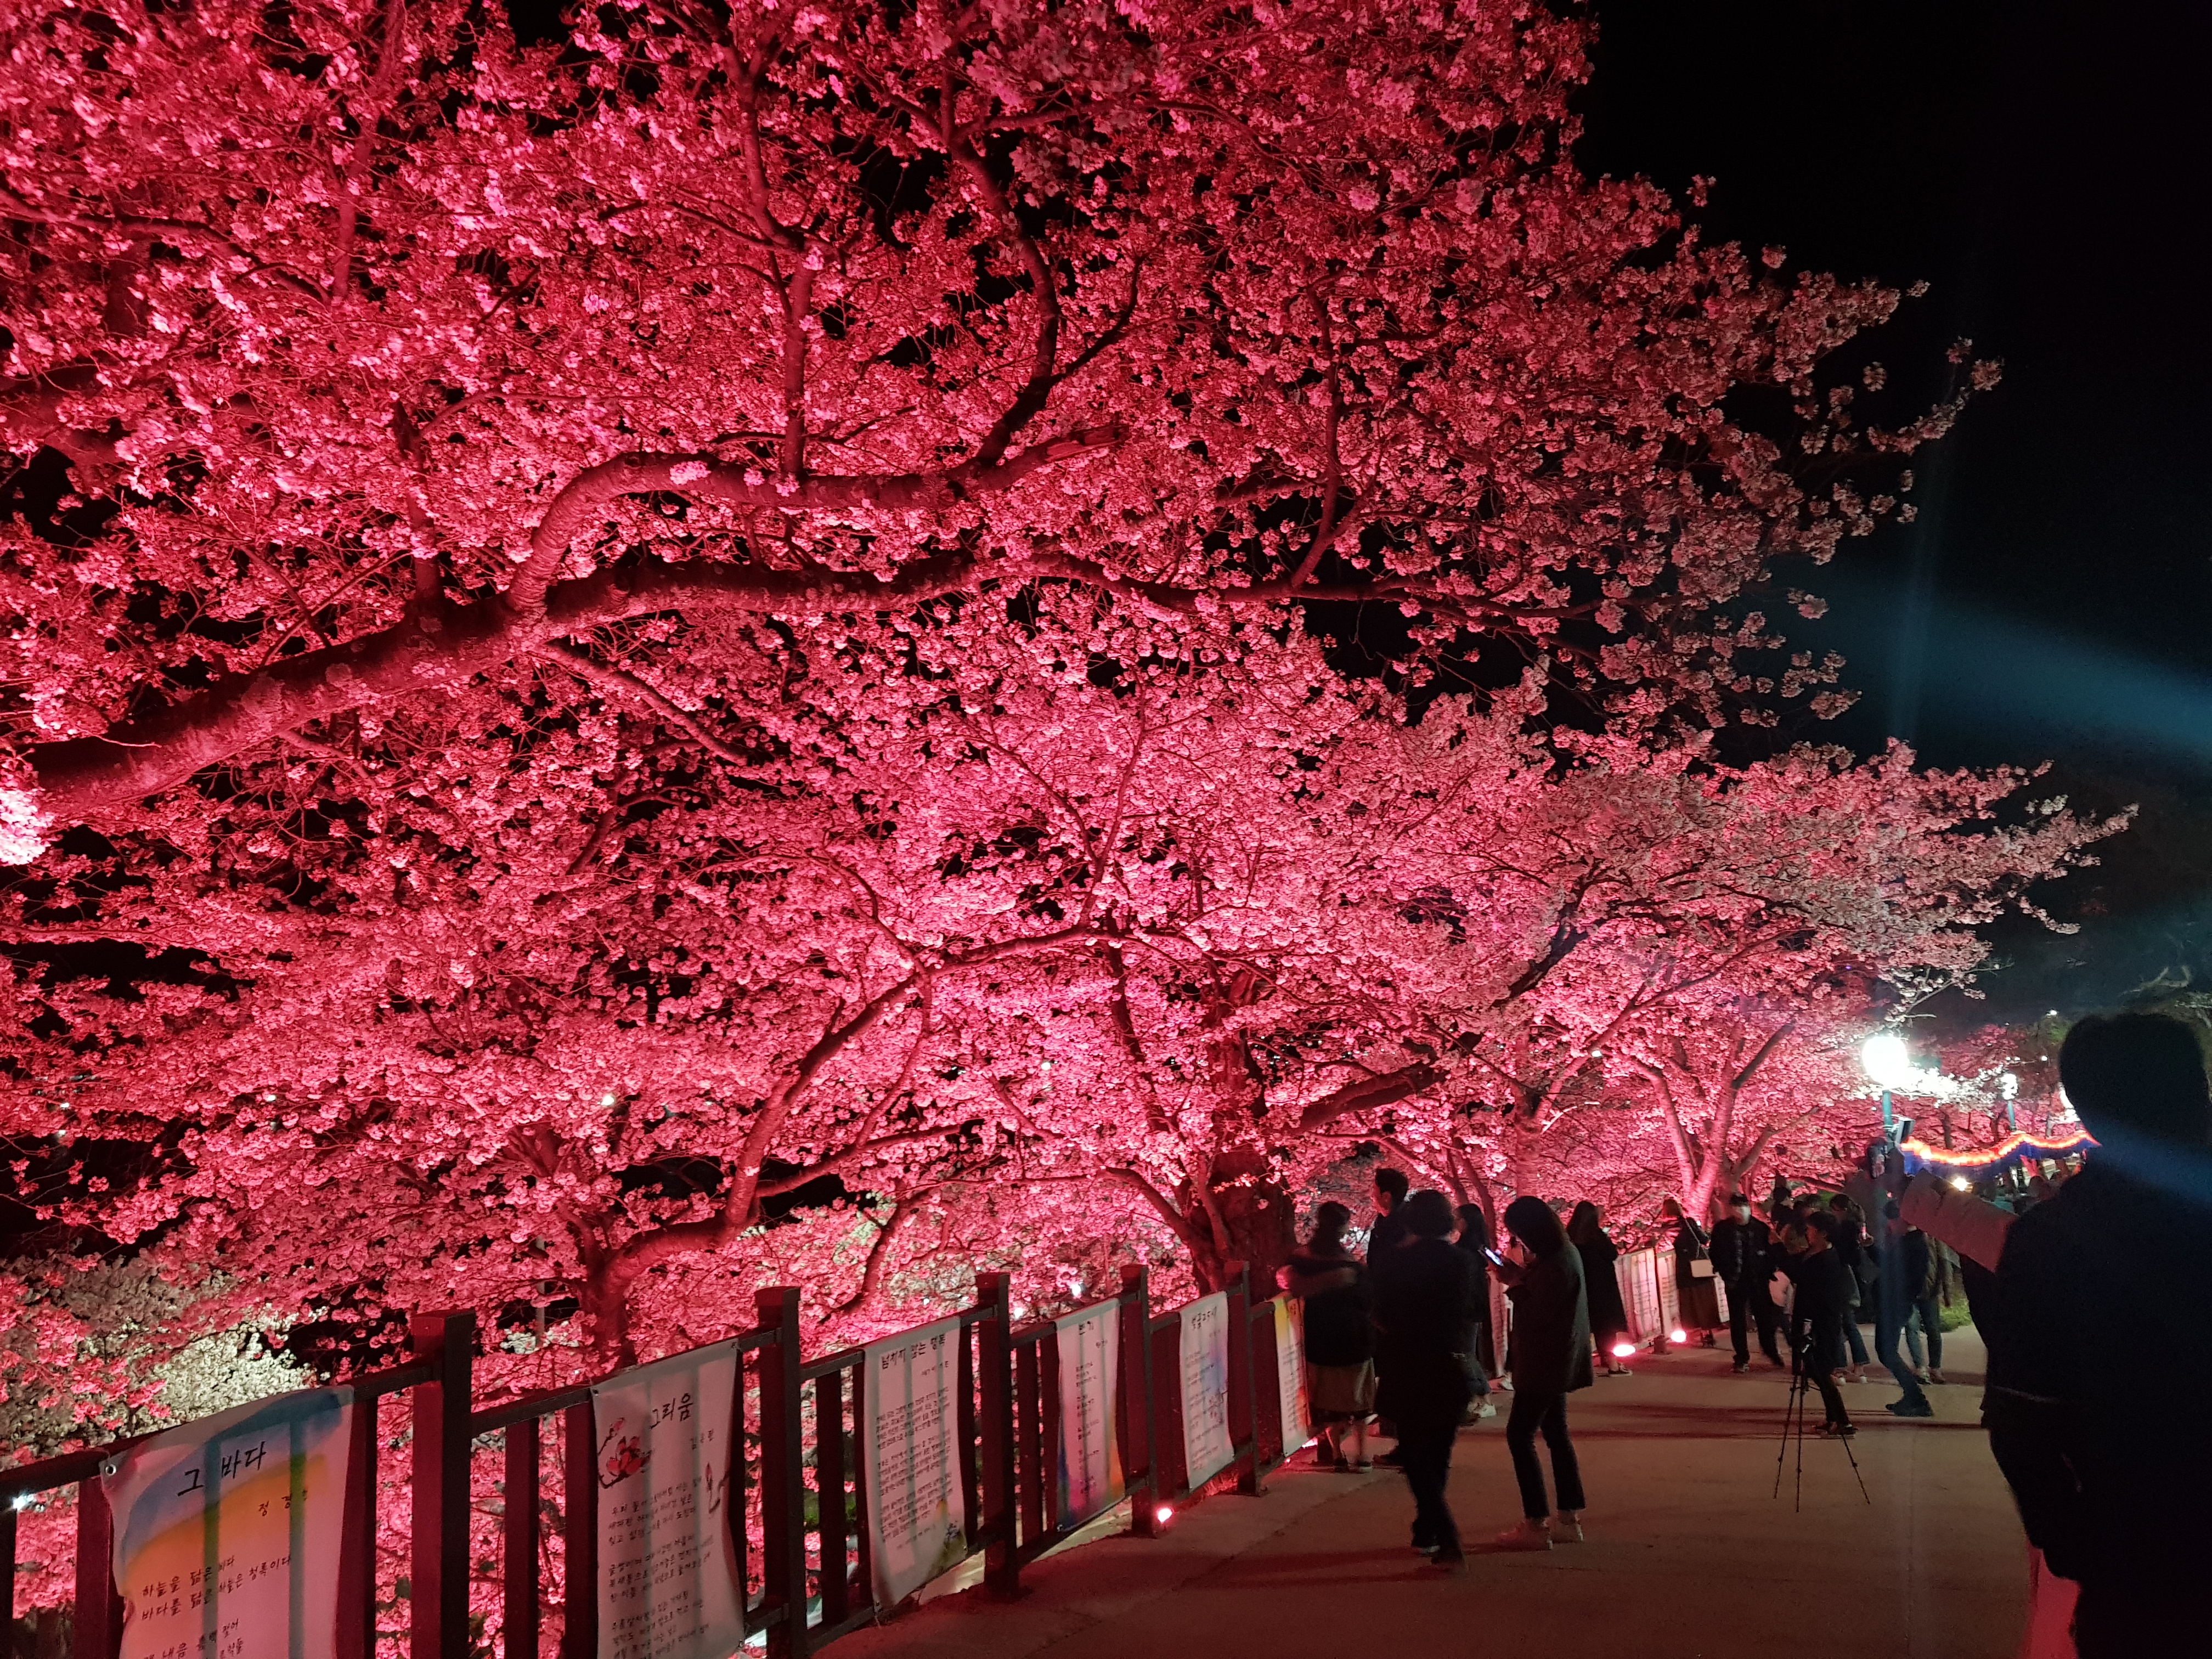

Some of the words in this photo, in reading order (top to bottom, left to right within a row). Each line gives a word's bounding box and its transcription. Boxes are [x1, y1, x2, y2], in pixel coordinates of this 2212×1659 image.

[650, 1392, 693, 1430] 그리움
[177, 1469, 204, 1497] 그
[221, 1441, 267, 1479] 바다
[142, 1576, 181, 1597] 하늘을
[142, 1598, 182, 1621] 바다를
[249, 1554, 291, 1581] 청록이다
